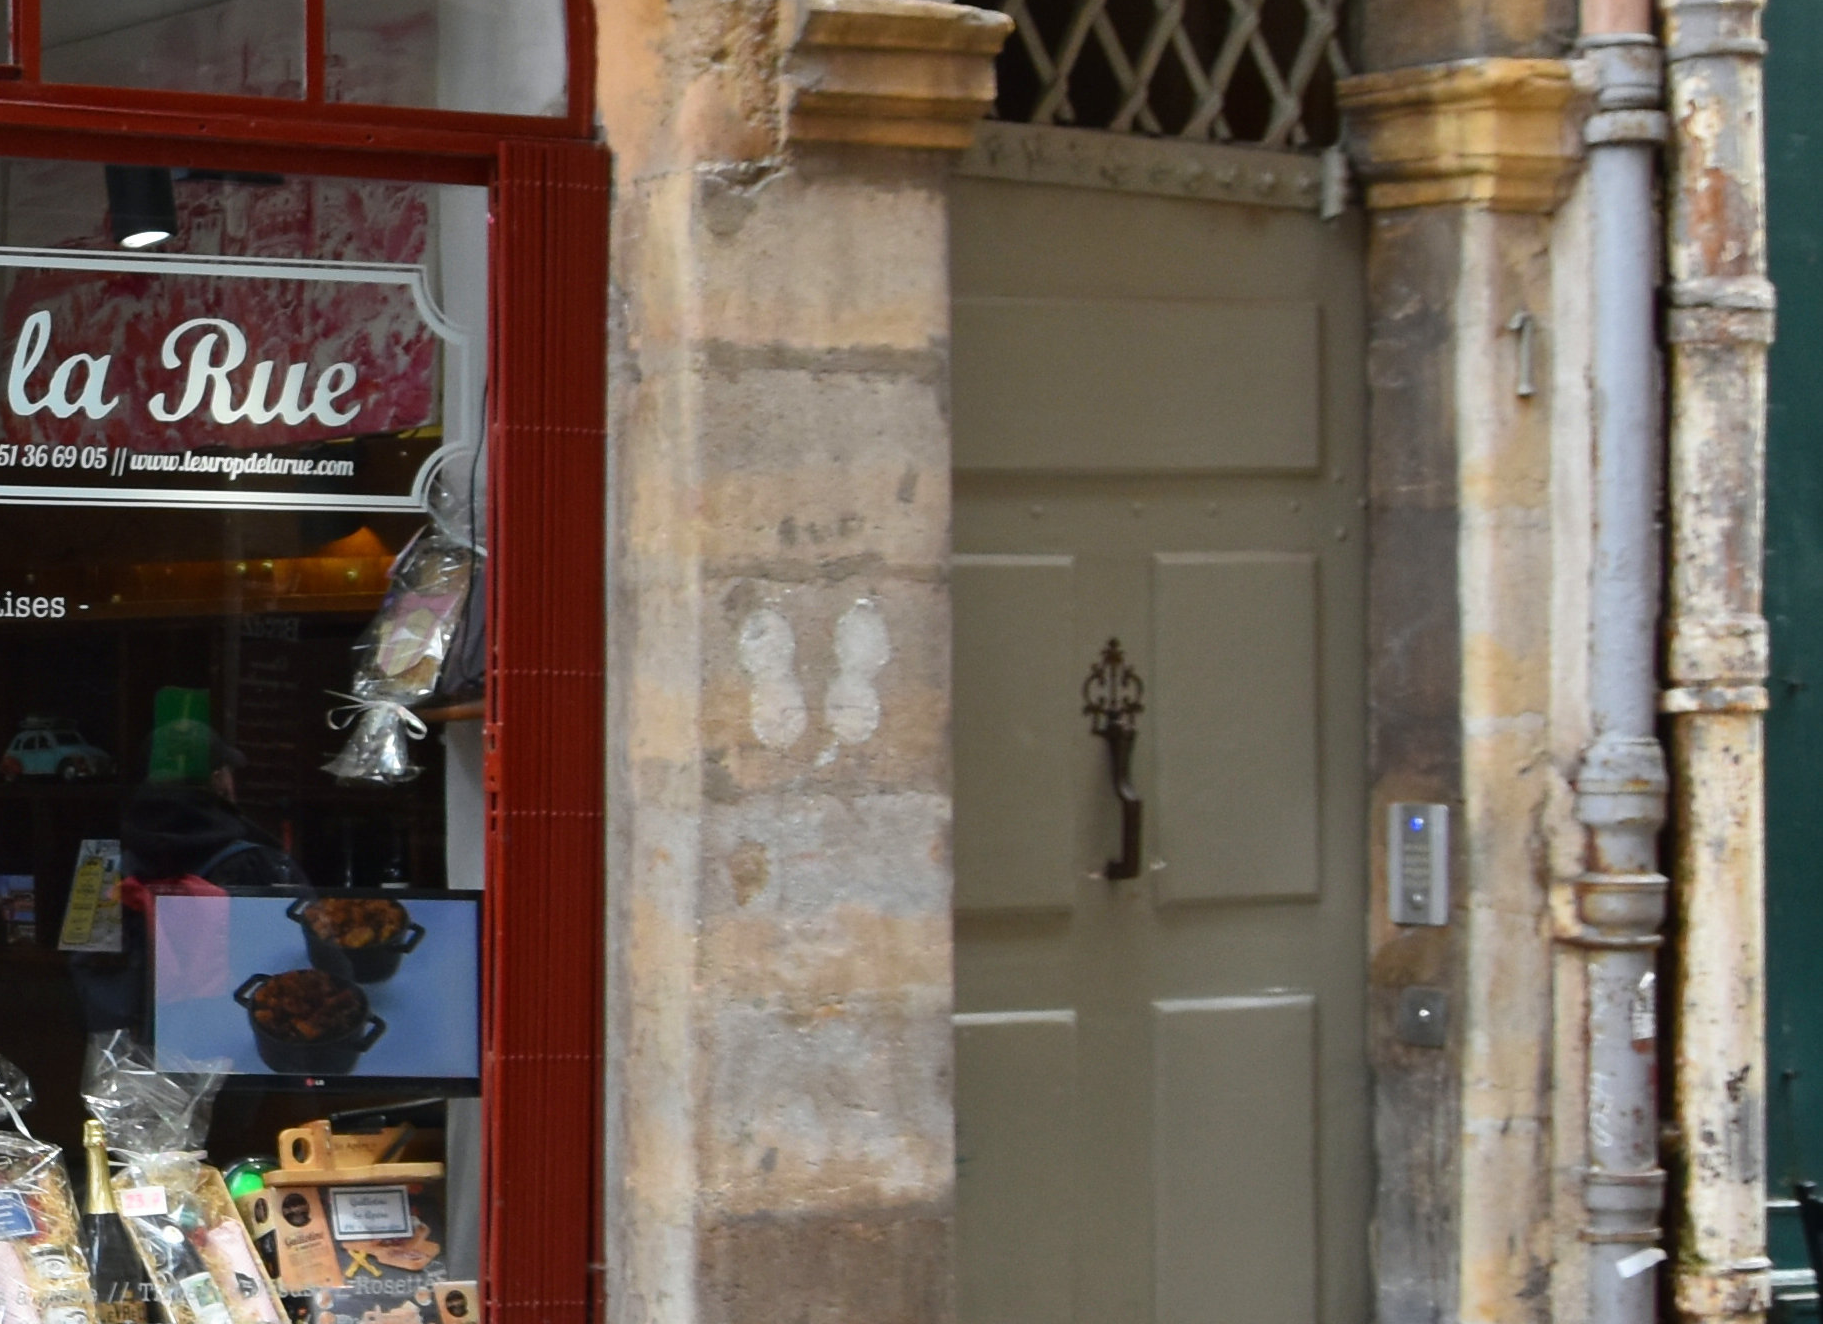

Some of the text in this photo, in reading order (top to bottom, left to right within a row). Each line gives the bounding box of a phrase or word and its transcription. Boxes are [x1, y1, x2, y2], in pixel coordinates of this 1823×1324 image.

[8, 310, 118, 421] la
[148, 319, 360, 429] Rue
[21, 444, 47, 468] 36
[52, 445, 78, 468] 69
[80, 446, 107, 469] 05
